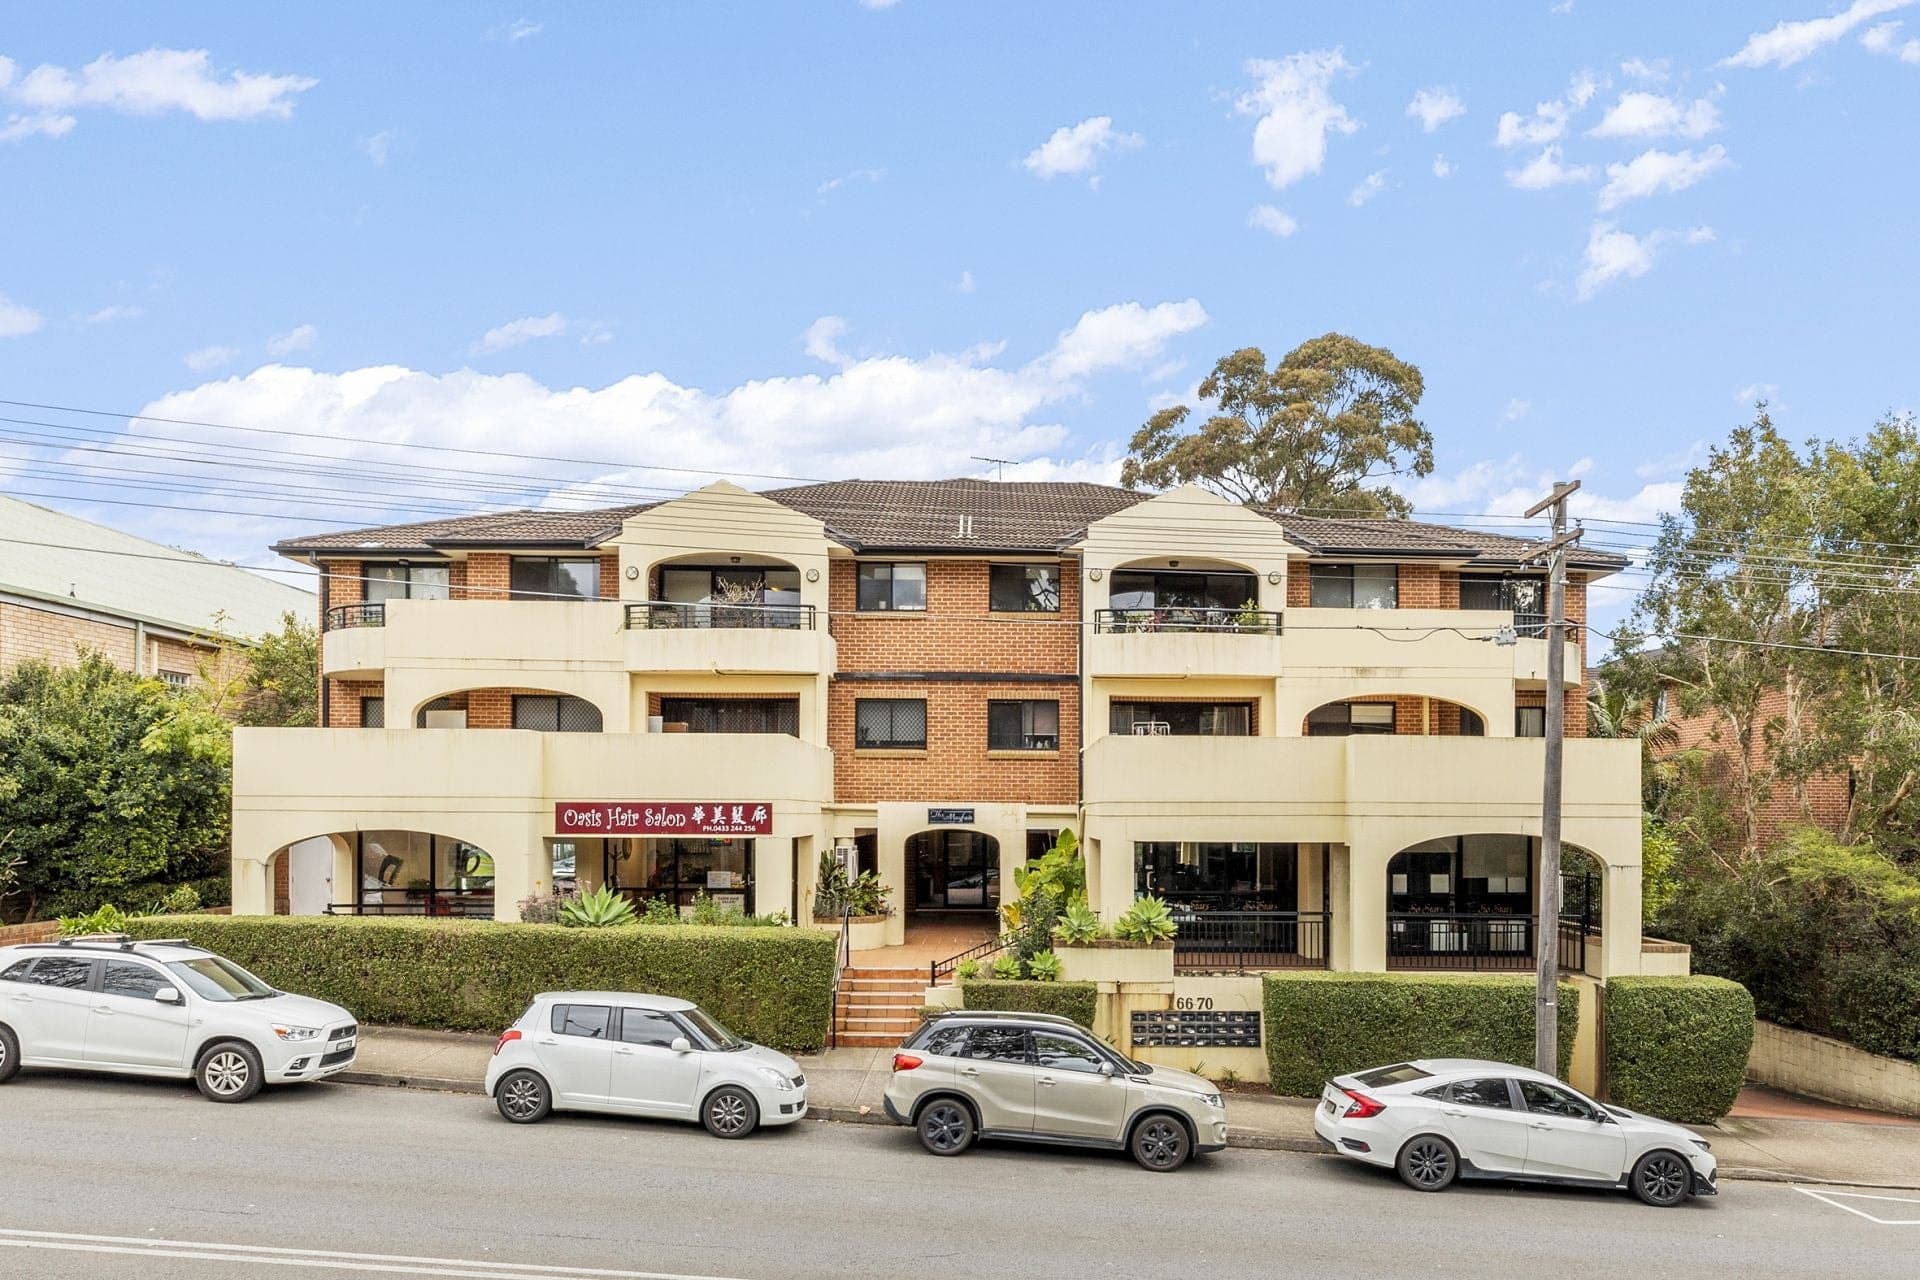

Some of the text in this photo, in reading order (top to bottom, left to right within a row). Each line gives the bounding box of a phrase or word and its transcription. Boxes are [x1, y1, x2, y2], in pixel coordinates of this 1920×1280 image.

[564, 806, 686, 830] Oasis Hair Salon
